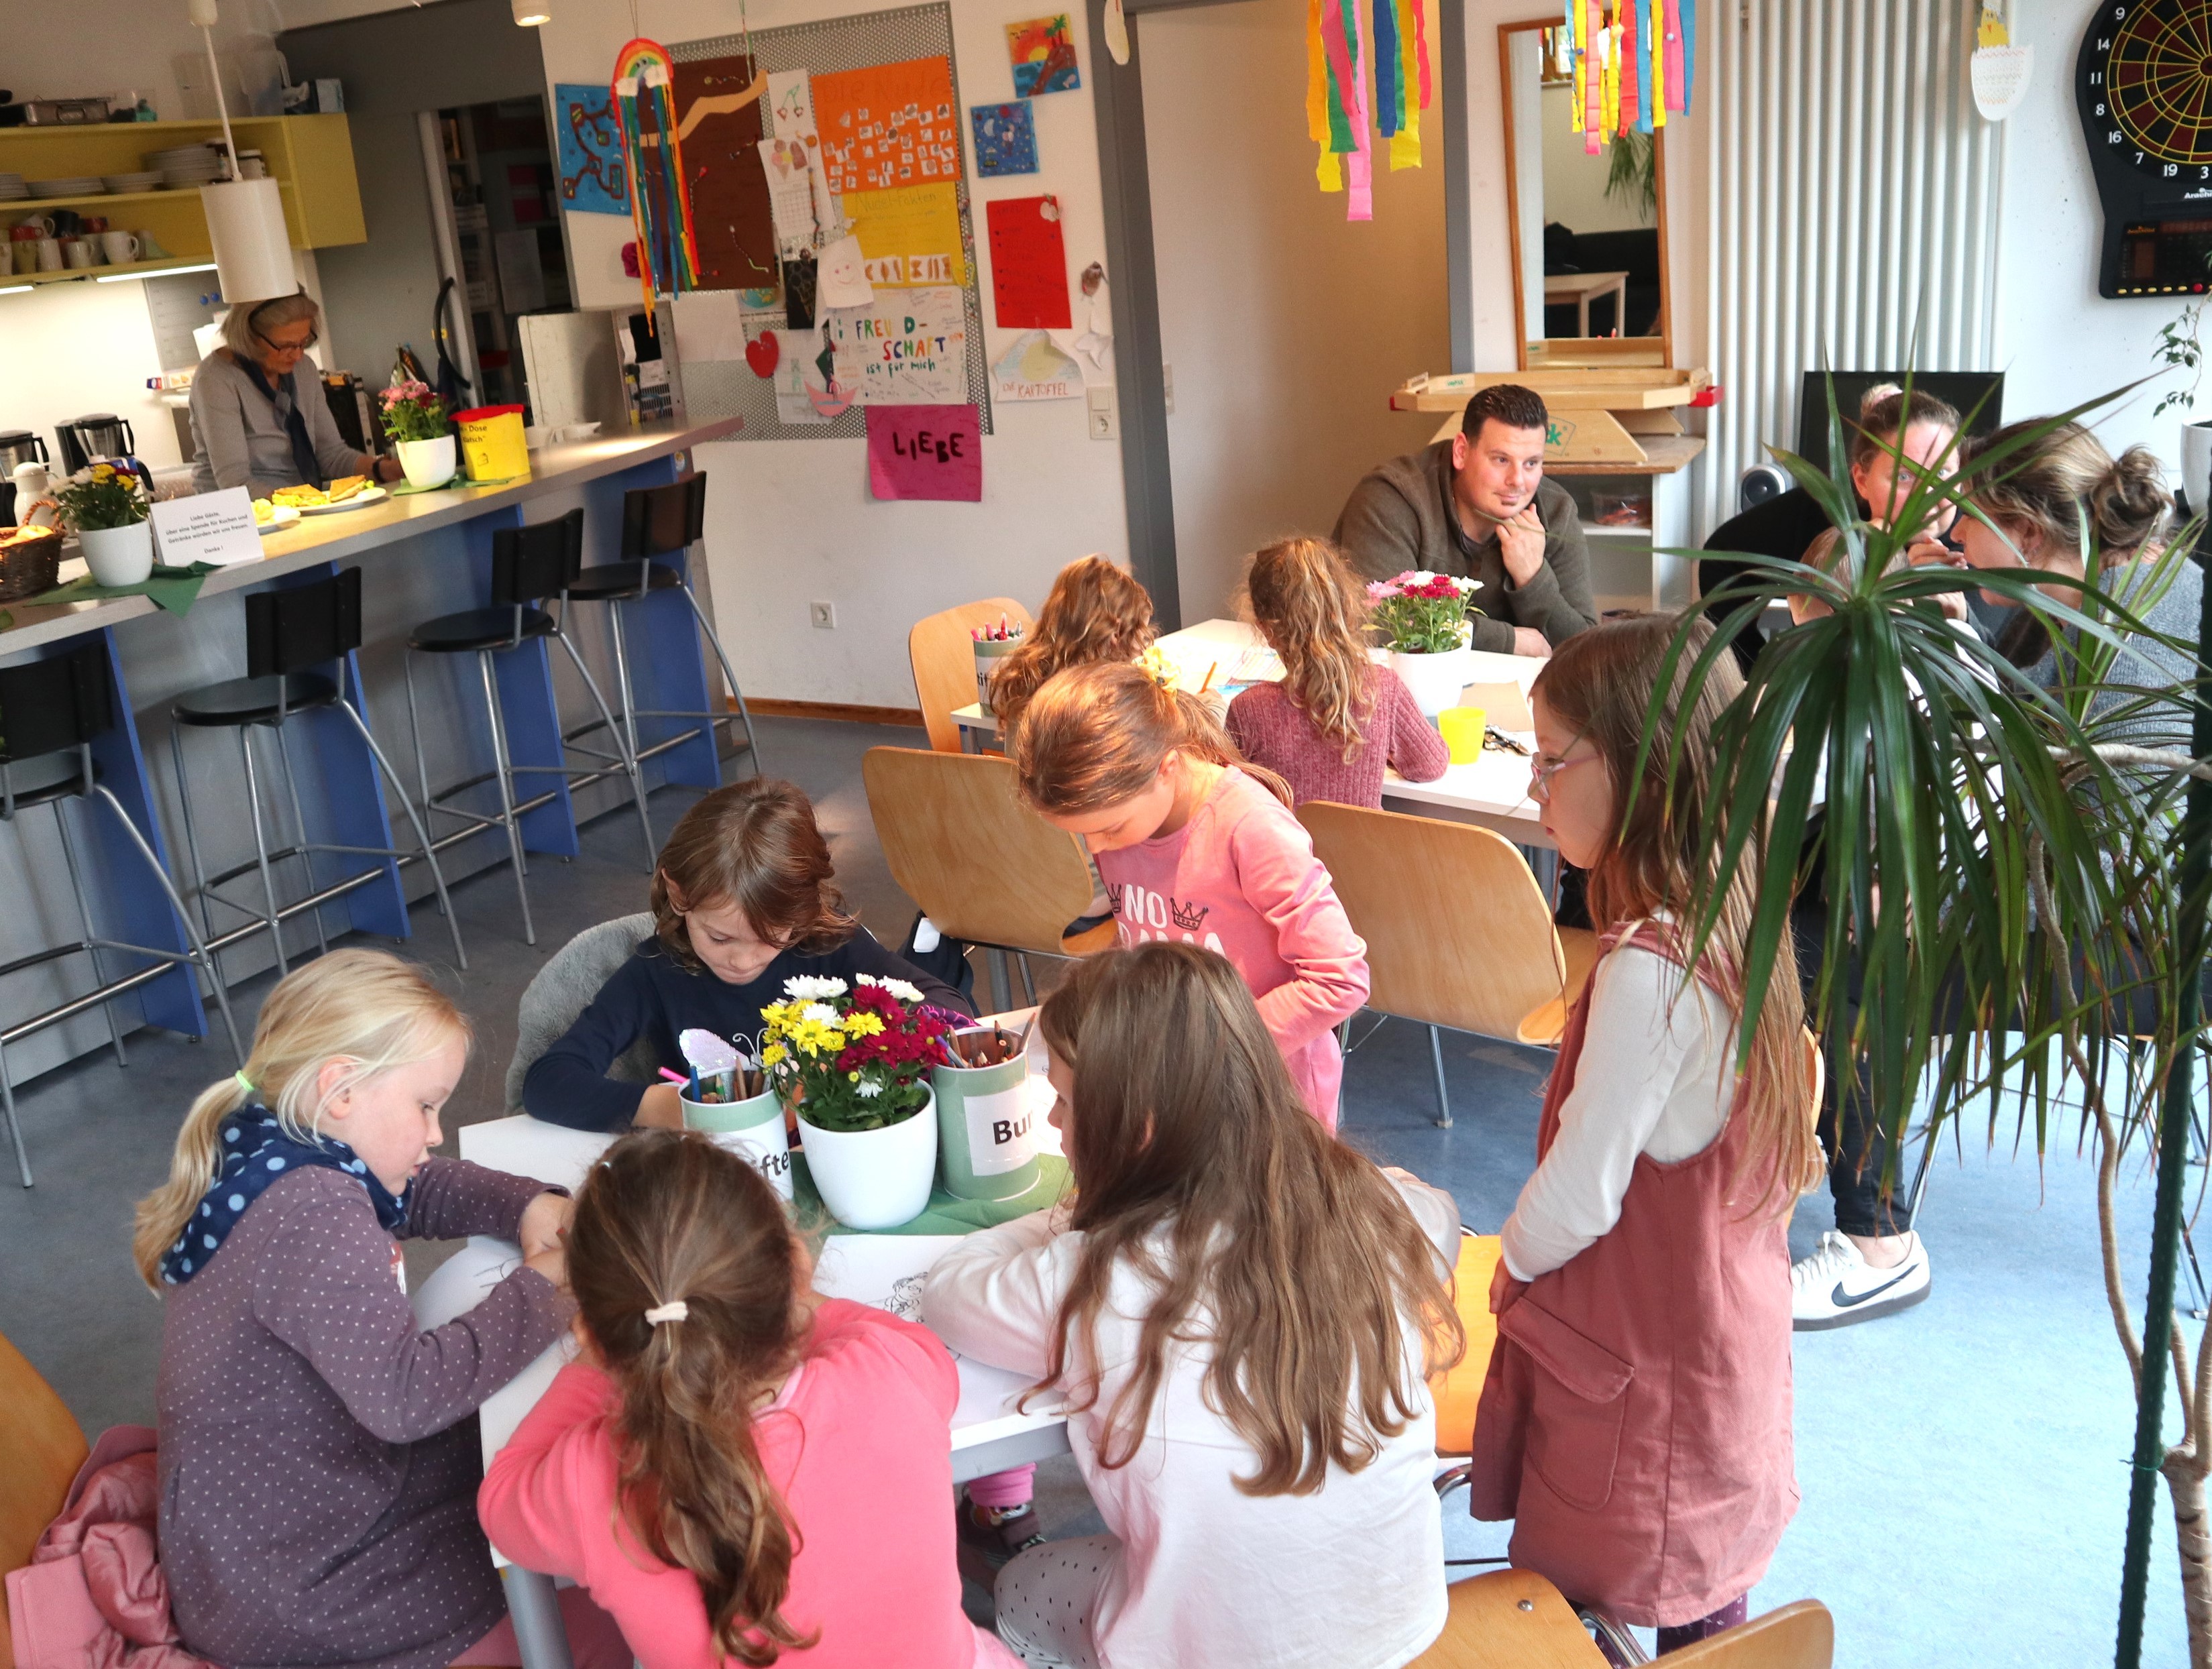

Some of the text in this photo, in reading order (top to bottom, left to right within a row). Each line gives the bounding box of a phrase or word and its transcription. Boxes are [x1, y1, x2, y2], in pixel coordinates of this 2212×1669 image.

[2115, 7, 2125, 20] 9
[2097, 38, 2110, 51] 14
[2090, 72, 2101, 84] 11
[2095, 103, 2105, 116] 8
[2108, 130, 2122, 143] 16
[2136, 152, 2144, 164] 7
[2162, 164, 2178, 177] 19
[2200, 166, 2209, 179] 3
[883, 336, 946, 361] SCHAFT
[866, 362, 881, 374] ist
[910, 358, 936, 372] mich
[1017, 382, 1068, 398] KARTOFFEL
[468, 424, 488, 433] Dose
[892, 430, 965, 463] LIEBE
[1125, 883, 1168, 929] NO
[751, 1151, 789, 1179] fte
